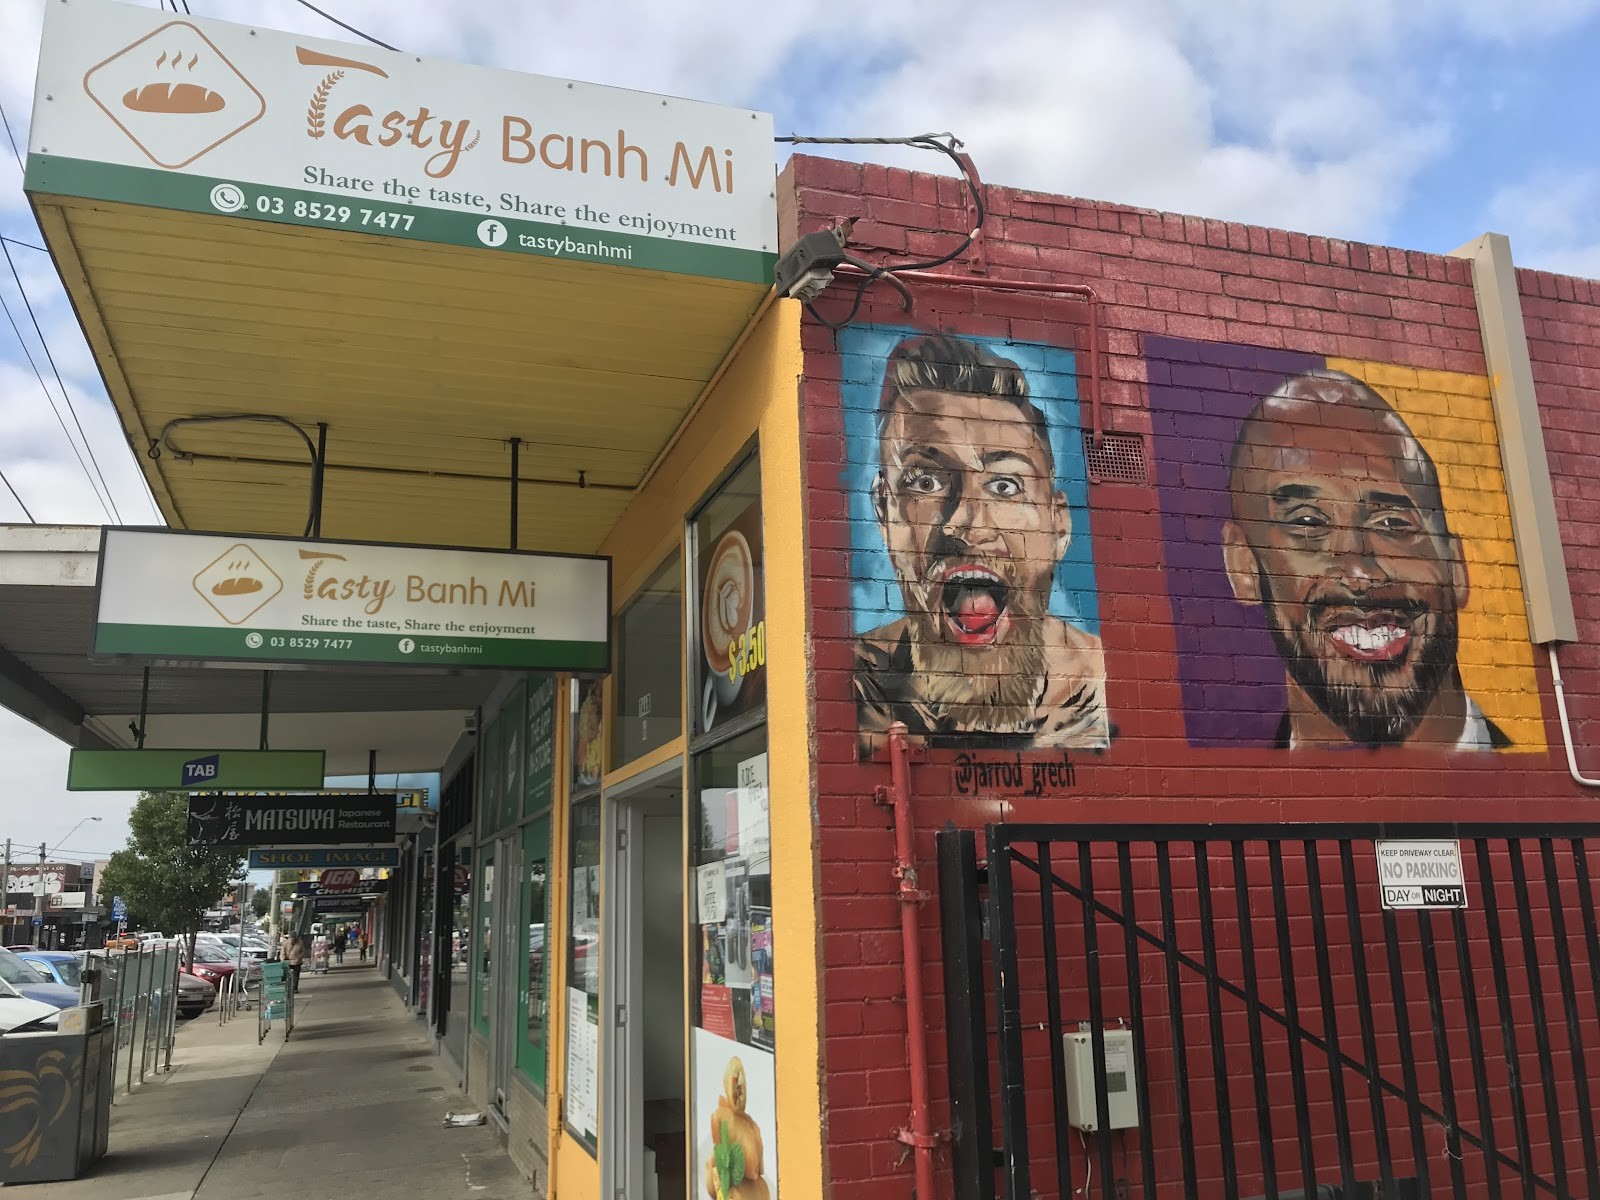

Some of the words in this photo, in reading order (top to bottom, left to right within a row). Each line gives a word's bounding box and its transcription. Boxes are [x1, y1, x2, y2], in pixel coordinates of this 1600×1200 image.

[295, 45, 480, 178] Tasty
[502, 115, 648, 182] Banh
[669, 141, 733, 194] Mi
[303, 166, 374, 192] Share
[382, 178, 421, 199] the
[429, 187, 492, 212] taste,
[499, 193, 566, 218] Share
[575, 205, 610, 224] the
[618, 213, 737, 241] enjoyment
[256, 195, 284, 214] 03
[293, 201, 351, 223] 8529
[359, 209, 415, 231] 7477
[518, 233, 632, 260] tastybanhmi
[298, 549, 396, 615] Tasty
[406, 575, 487, 606] Banh
[498, 580, 536, 608] Mi
[301, 614, 338, 627] Share
[342, 617, 363, 628] the
[367, 618, 401, 631] taste,
[404, 619, 441, 631] Share
[445, 621, 465, 632] the
[469, 622, 536, 636] enjoyment
[270, 637, 285, 647] 03
[289, 637, 319, 648] 8529
[323, 639, 353, 649] 7477
[420, 643, 483, 655] tastybanhmi
[186, 764, 215, 777] TAB
[955, 752, 1076, 797] @jarrod_grech
[245, 808, 335, 831] MATSUYA
[338, 808, 382, 818] Japanese
[338, 820, 391, 829] Restaurant
[260, 853, 313, 864] SHOE
[325, 852, 388, 862] IMAGE
[1381, 849, 1398, 857] KEEP
[1400, 849, 1432, 857] DRIVEWAY
[324, 870, 356, 885] IGA
[1383, 862, 1403, 878] NO
[1406, 862, 1458, 878] PARKING
[315, 886, 373, 895] CHEMIST
[1387, 889, 1410, 902] DAY
[1424, 889, 1460, 902] NIGHT
